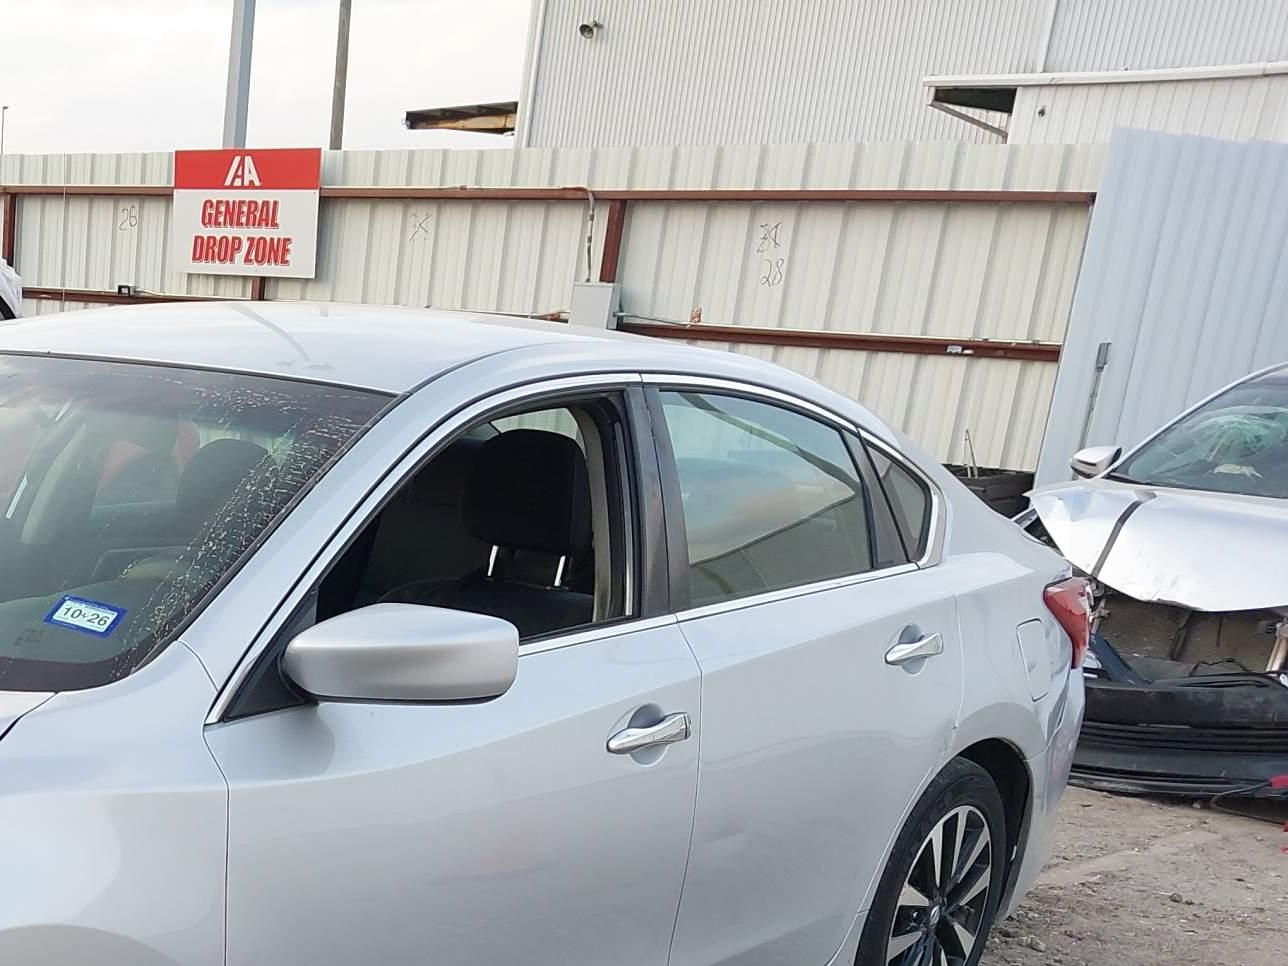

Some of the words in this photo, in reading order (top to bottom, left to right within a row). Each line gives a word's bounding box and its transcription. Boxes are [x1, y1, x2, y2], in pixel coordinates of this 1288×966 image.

[201, 199, 279, 229] GENERAL
[191, 235, 243, 264] DROP
[243, 236, 292, 266] ZONE
